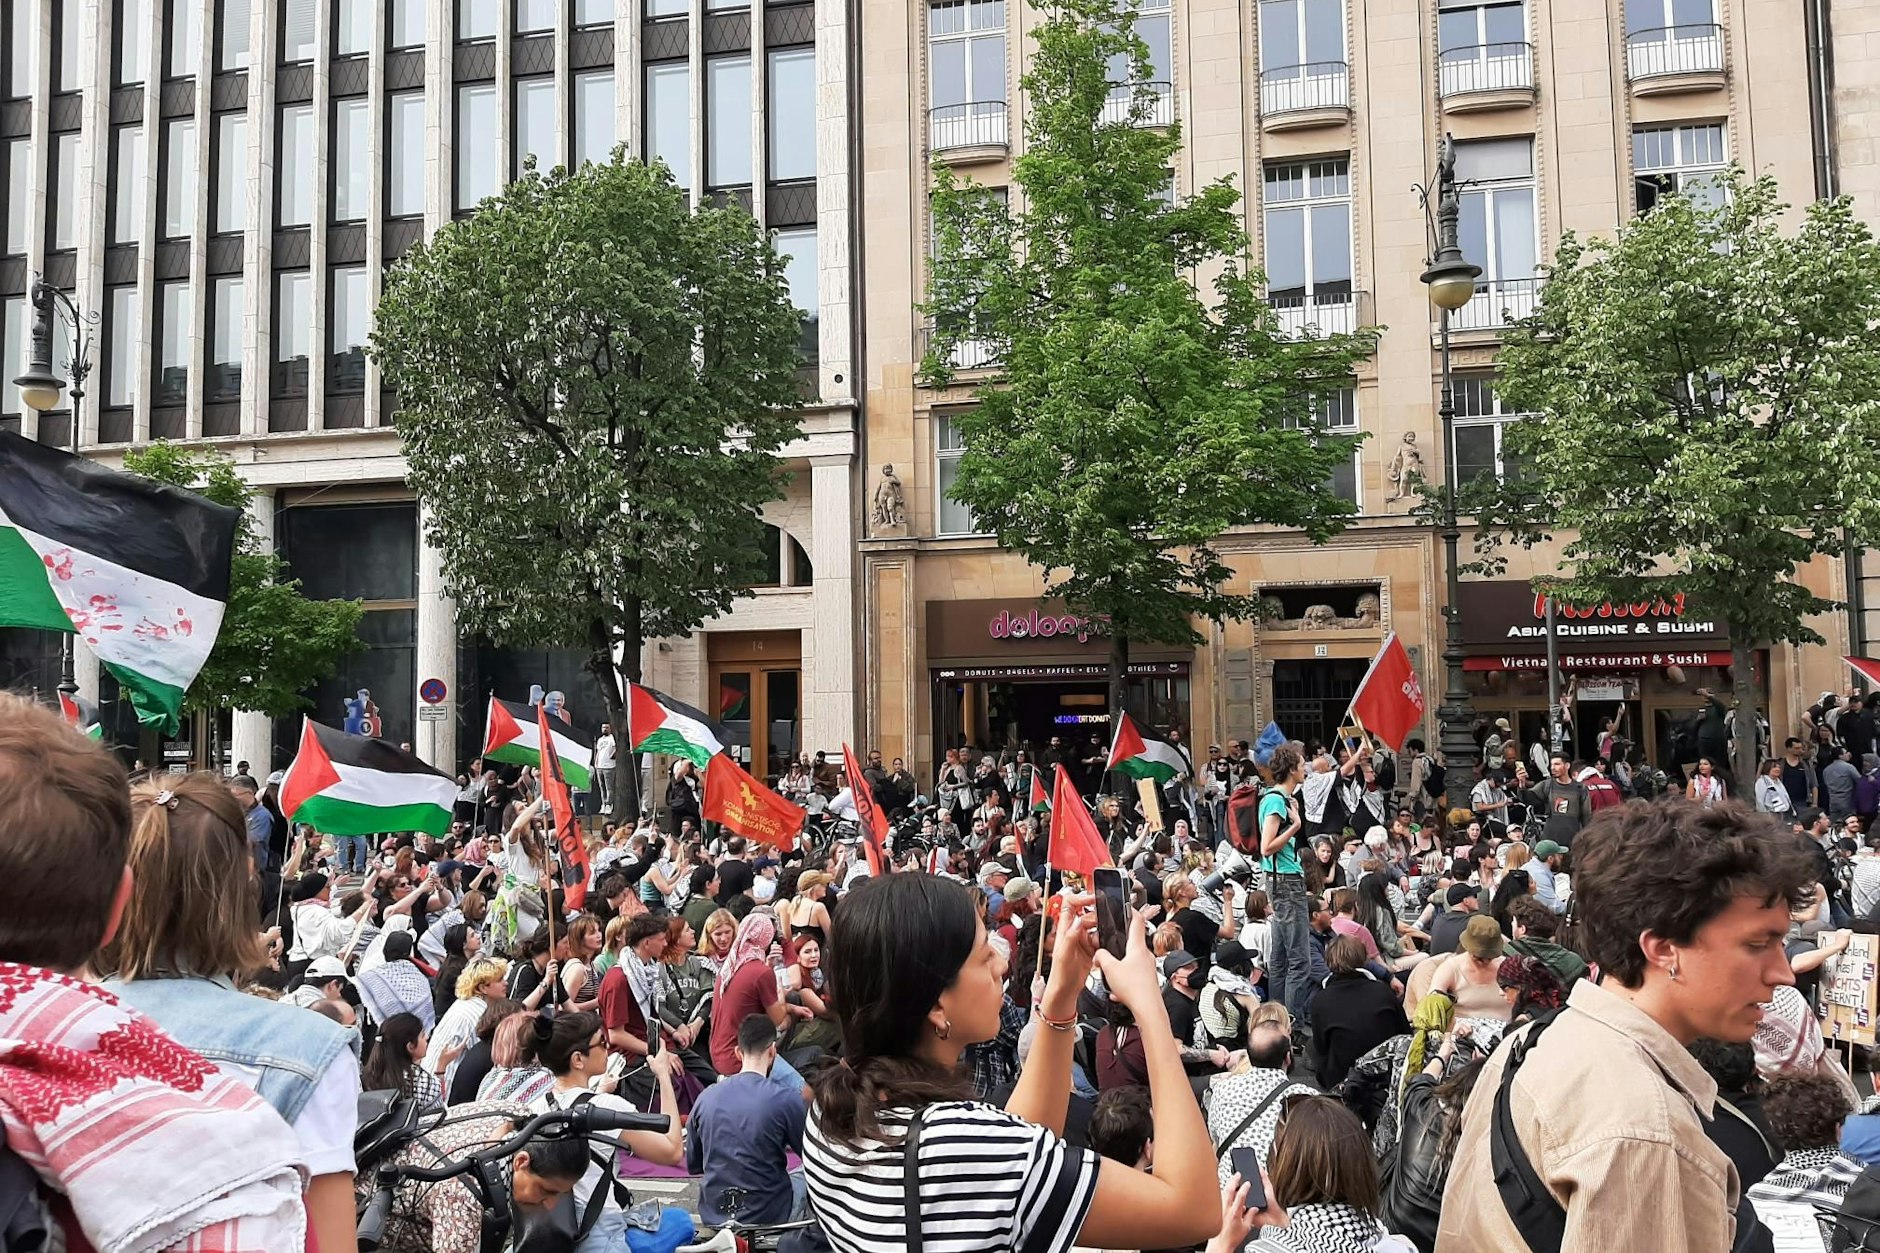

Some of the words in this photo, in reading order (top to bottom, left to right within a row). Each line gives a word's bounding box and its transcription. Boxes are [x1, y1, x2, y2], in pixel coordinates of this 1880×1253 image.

[1507, 625, 1548, 637] ASIA
[1556, 624, 1629, 636] CUISINE
[1634, 622, 1651, 634] &
[1657, 621, 1714, 633] SUSHI
[1502, 656, 1561, 668] Vietna
[1566, 655, 1648, 667] Restaurant
[1652, 653, 1662, 665] &
[1667, 652, 1708, 665] Sushi
[964, 669, 996, 677] DONUTS
[1046, 667, 1076, 675] KAFFEE
[725, 809, 776, 836] ORGANISATION
